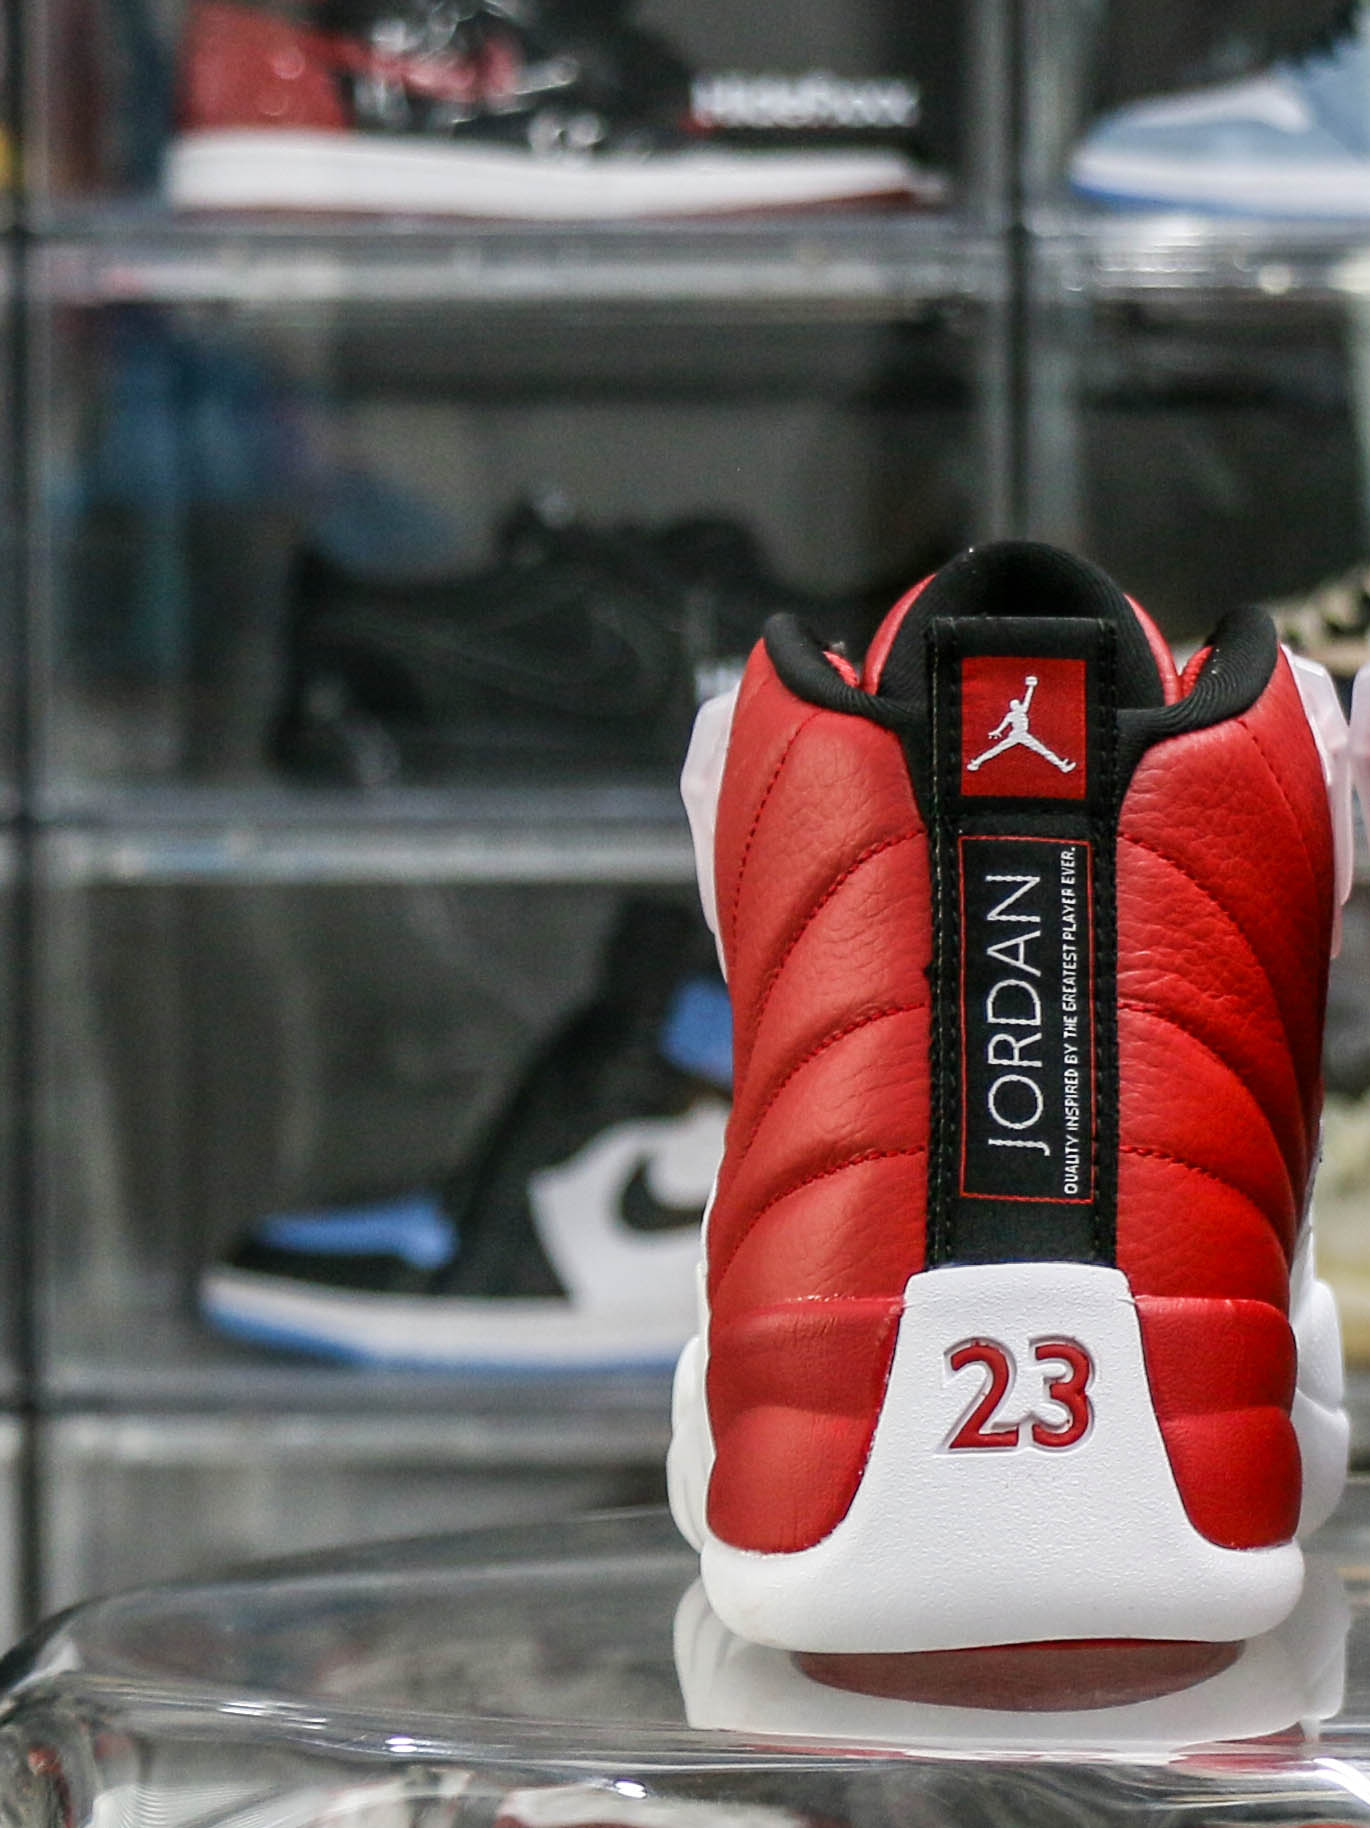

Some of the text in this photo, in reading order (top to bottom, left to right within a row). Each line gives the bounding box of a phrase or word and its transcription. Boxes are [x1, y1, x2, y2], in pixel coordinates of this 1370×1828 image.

[986, 875, 1050, 1156] JORDAN
[1060, 846, 1080, 1195] QUALITY INSPIRED BY THE GREATEST PLAYER EVER.
[945, 1338, 1094, 1452] 23
